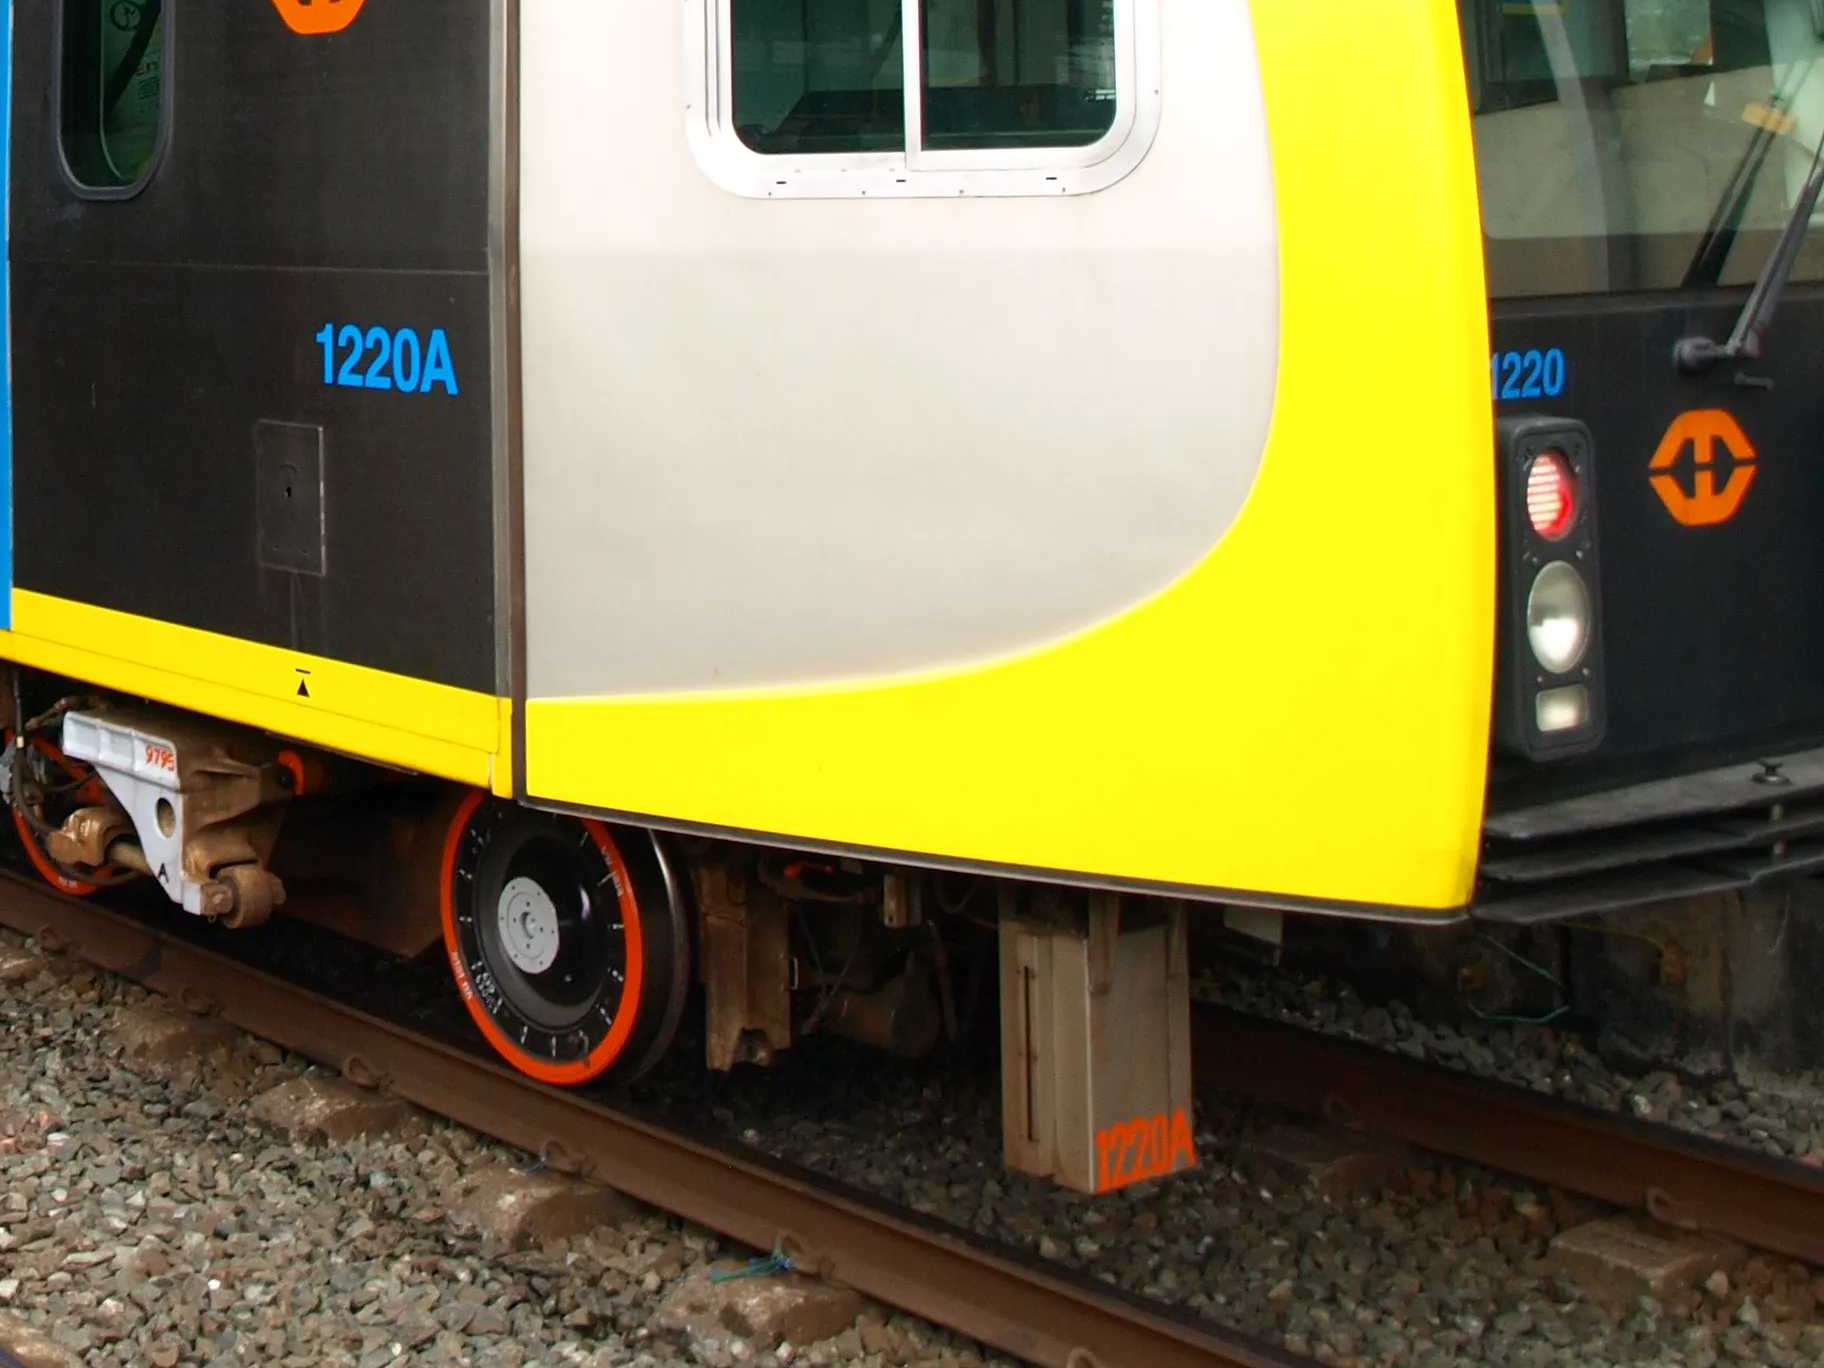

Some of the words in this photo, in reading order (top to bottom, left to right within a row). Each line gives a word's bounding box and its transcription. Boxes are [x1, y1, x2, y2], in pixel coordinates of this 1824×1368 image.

[316, 323, 459, 396] 1220A
[1491, 348, 1564, 400] 1220
[1096, 1106, 1197, 1194] 1220A
